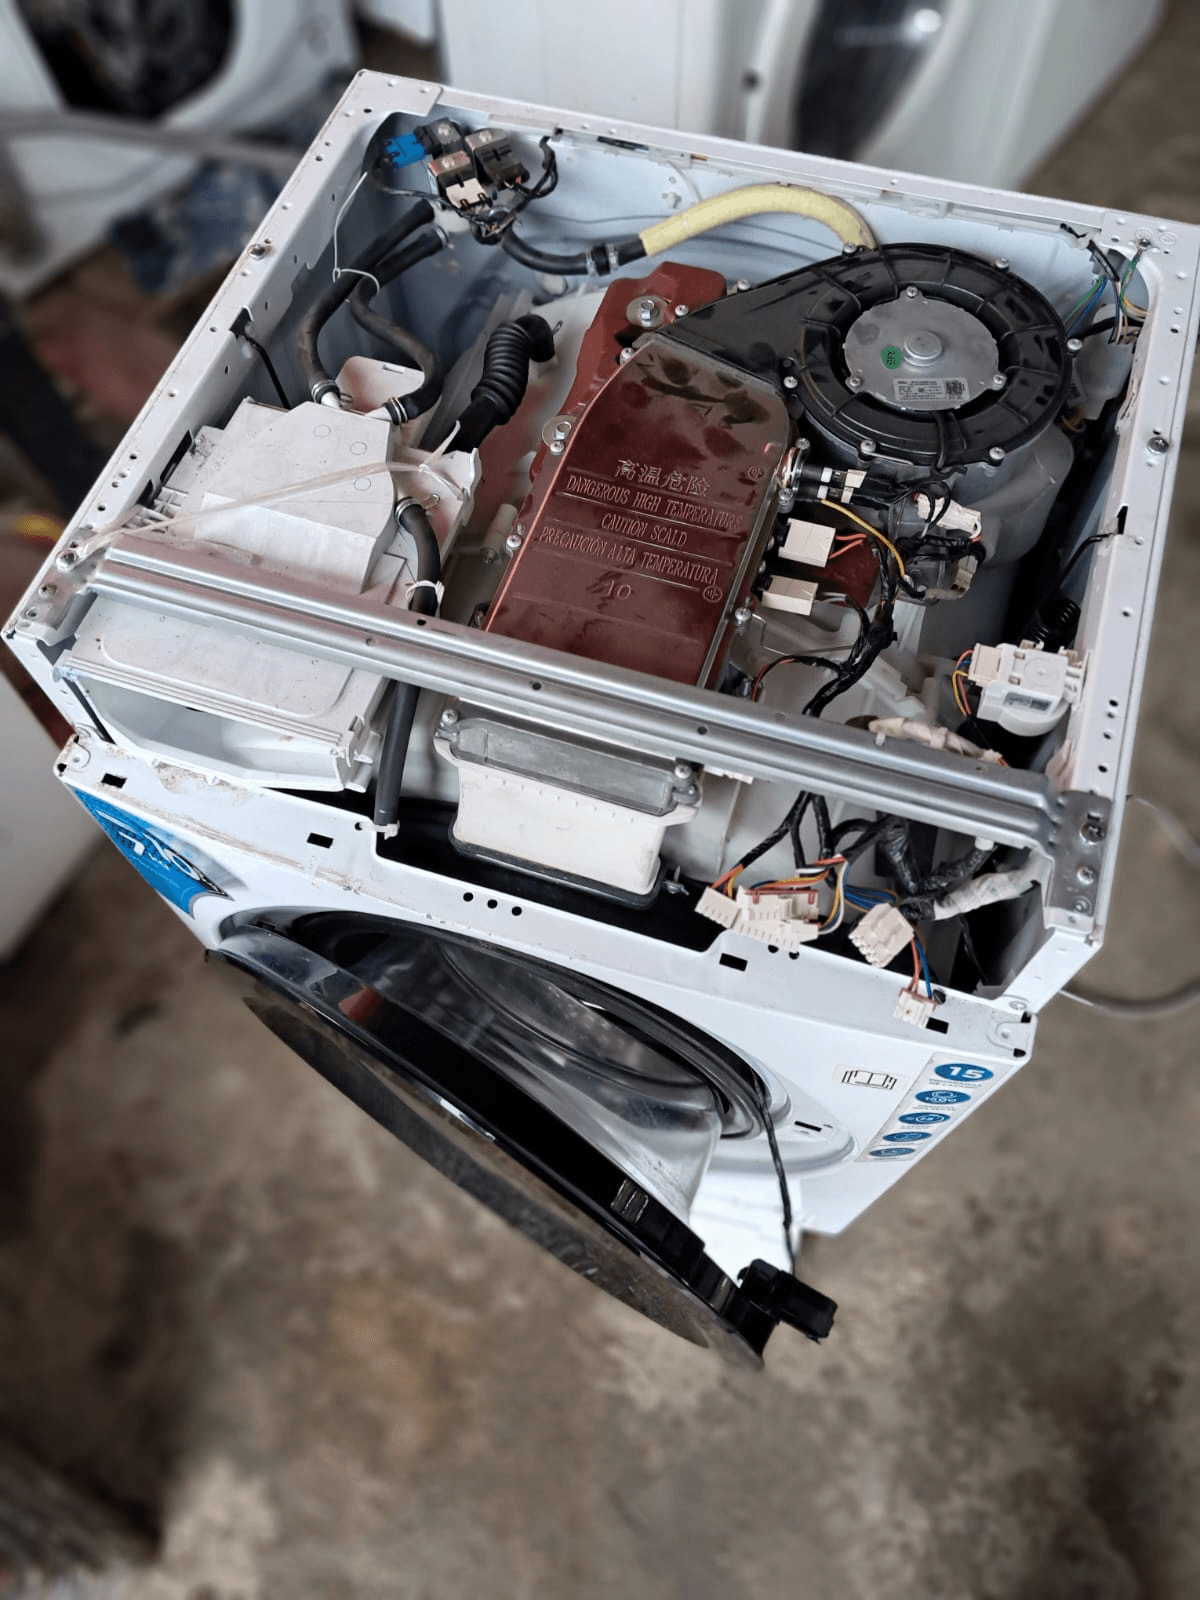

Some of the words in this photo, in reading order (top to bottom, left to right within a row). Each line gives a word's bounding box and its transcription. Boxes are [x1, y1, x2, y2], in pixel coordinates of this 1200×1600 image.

[566, 475, 631, 504] DANGEROUS
[634, 491, 660, 515] HIGH
[663, 499, 744, 531] TEMPERATURE
[601, 512, 648, 536] CAUTION
[650, 526, 688, 547] SCALD
[607, 545, 636, 565] ALTA
[641, 551, 719, 586] TEMPERATURA
[949, 1066, 985, 1079] 15
